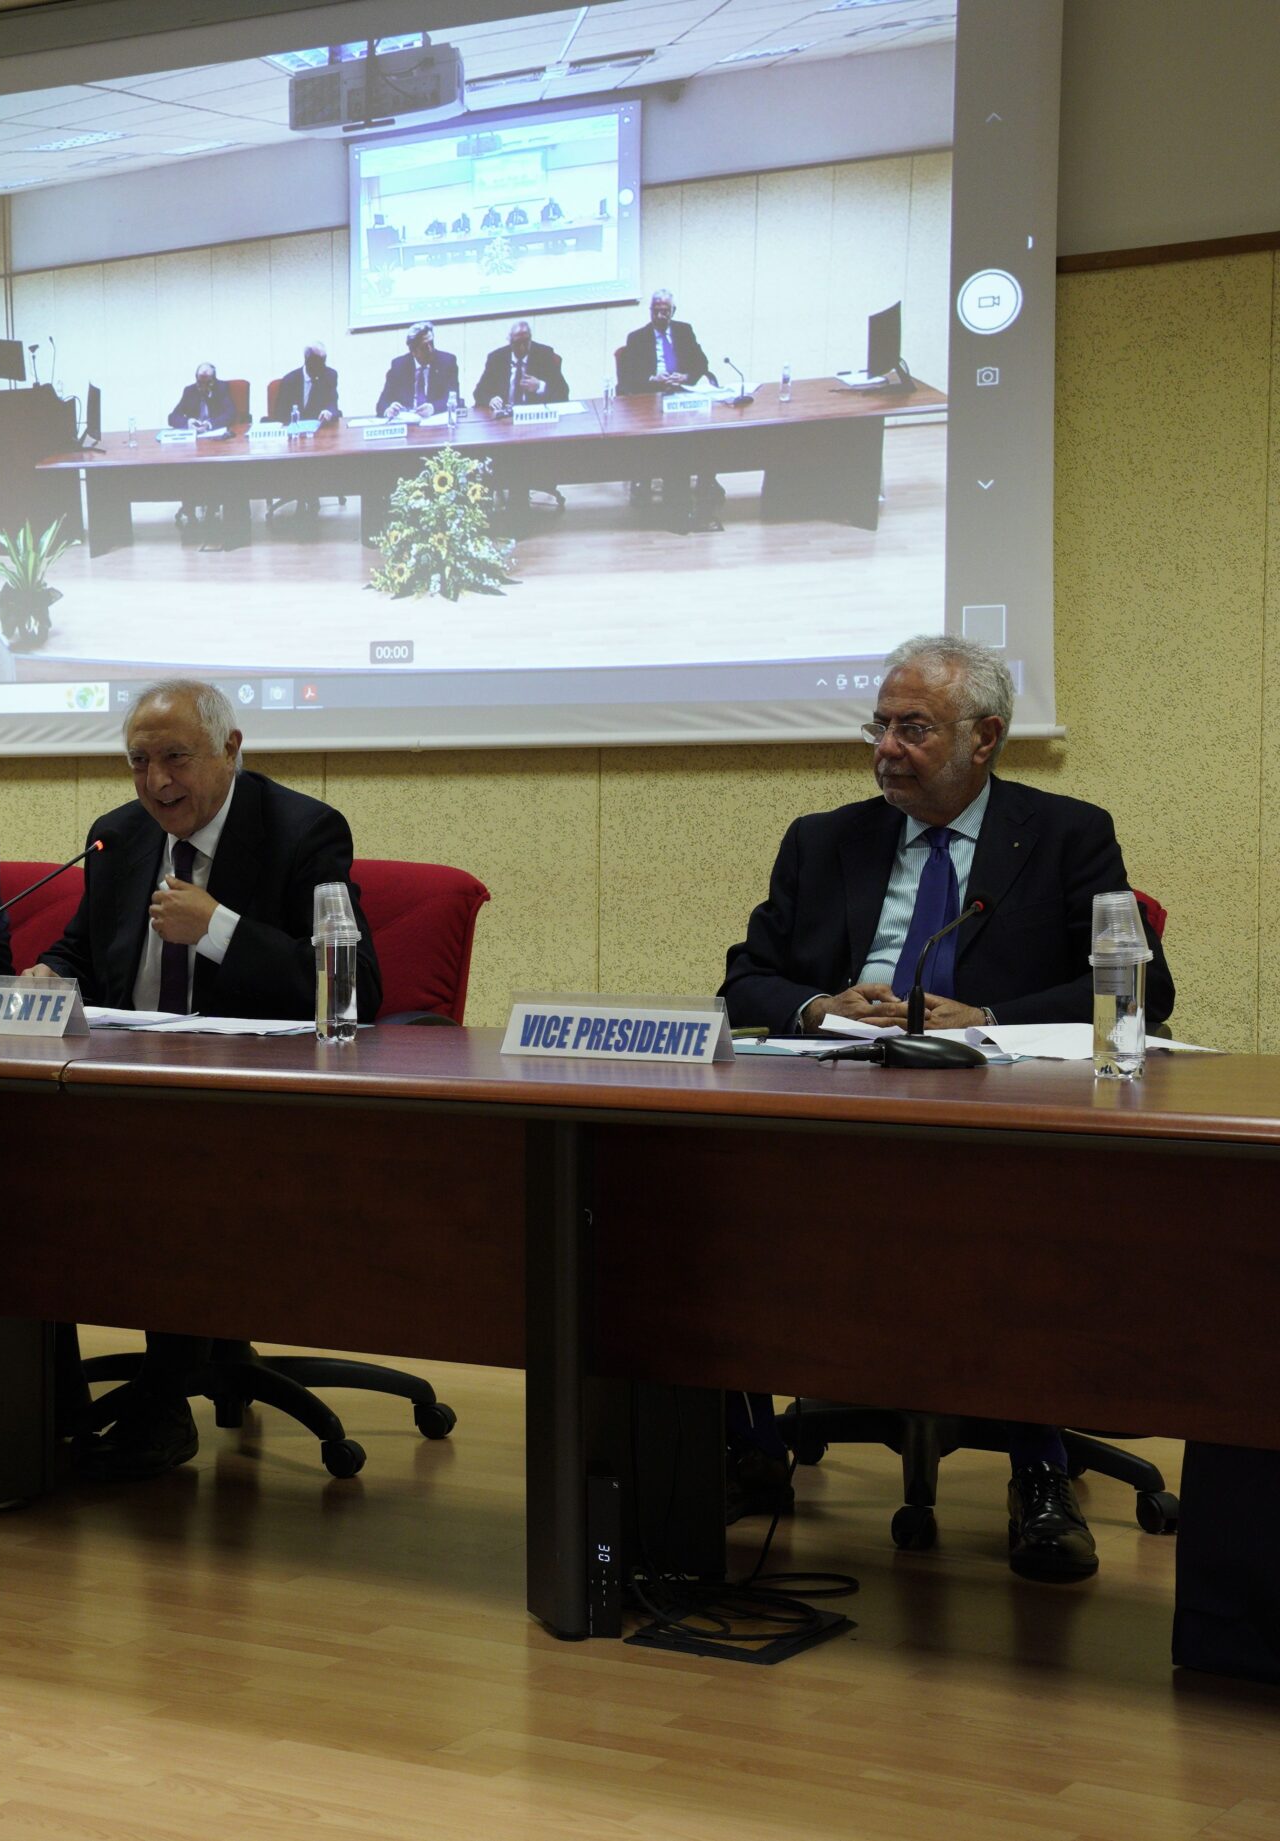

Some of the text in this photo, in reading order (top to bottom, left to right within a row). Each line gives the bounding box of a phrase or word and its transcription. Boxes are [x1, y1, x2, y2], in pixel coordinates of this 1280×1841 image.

[515, 411, 557, 421] PRESIDENTE
[375, 645, 409, 659] 00:00
[520, 1014, 711, 1057] VICE PRESIDENTE
